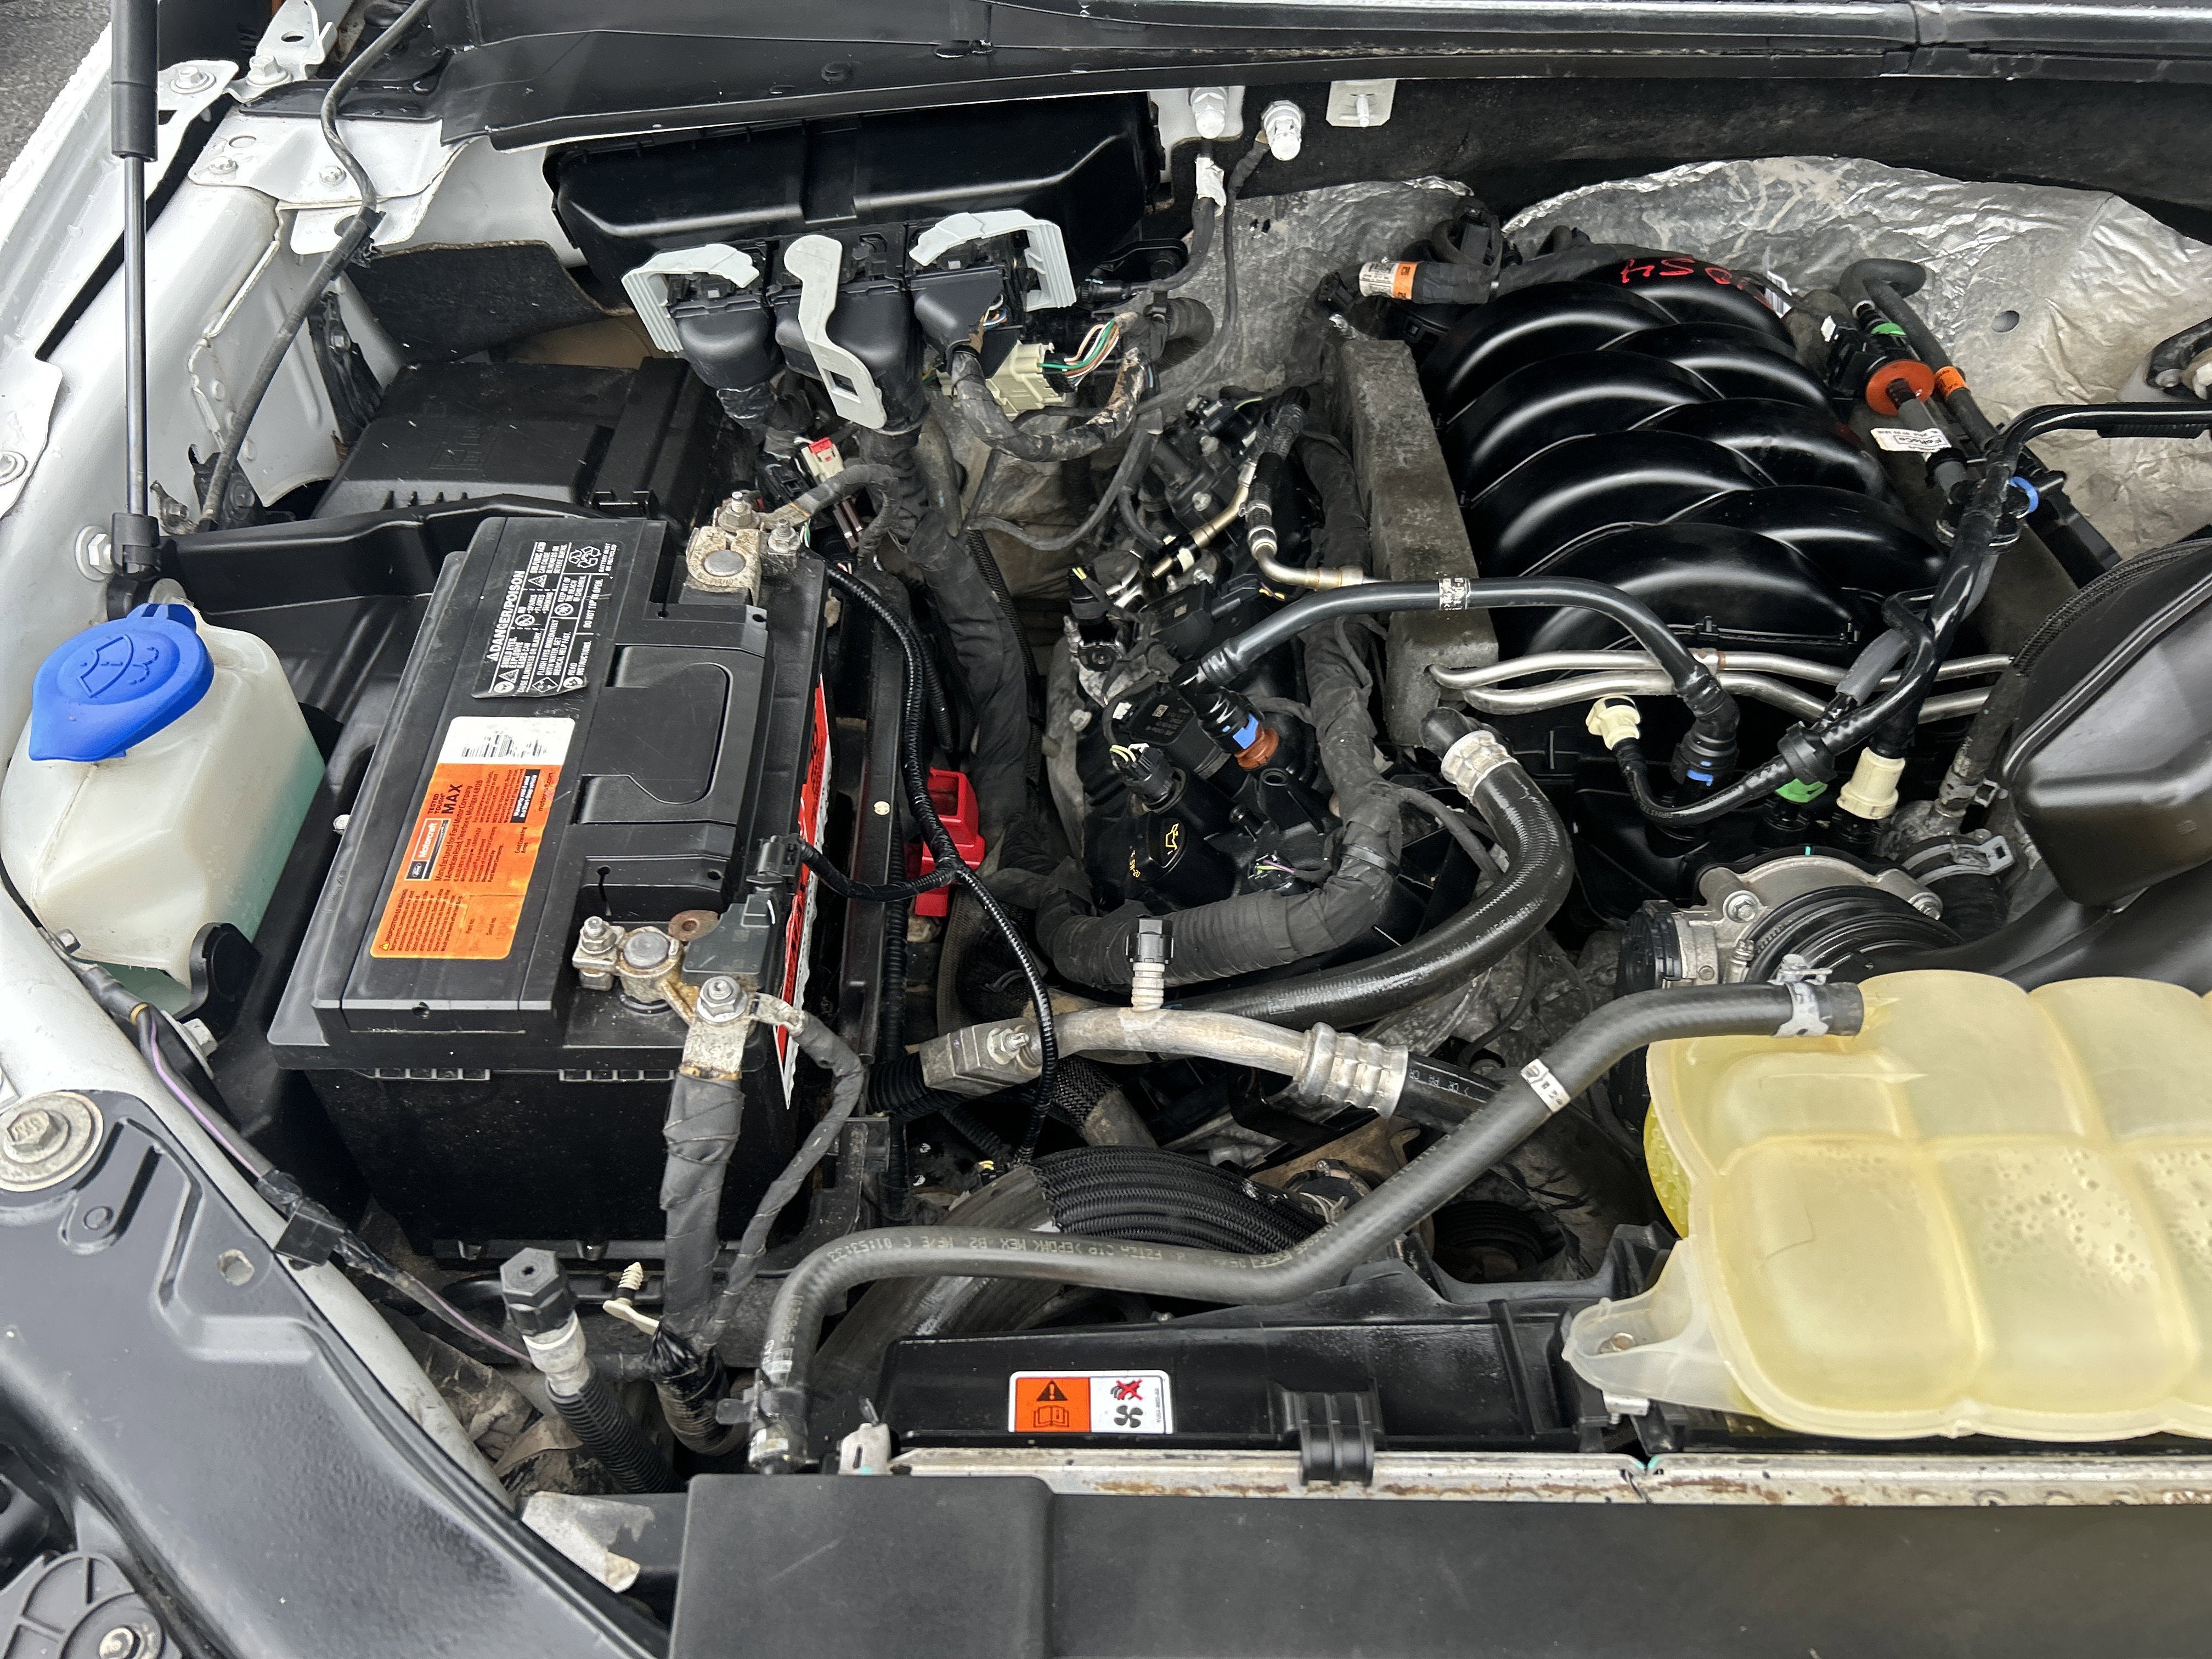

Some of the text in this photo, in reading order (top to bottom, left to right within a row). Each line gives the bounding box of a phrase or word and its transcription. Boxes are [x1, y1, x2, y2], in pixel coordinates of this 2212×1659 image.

[537, 542, 546, 552] ACID
[607, 544, 617, 565] RECYCLED
[538, 552, 550, 573] CAN CAUSE
[546, 552, 558, 573] BLINDNESS
[554, 559, 563, 573] SEVERE
[599, 554, 607, 572] BATTERY
[561, 583, 569, 591] OUT
[568, 580, 578, 594] REACH
[557, 592, 566, 602] KEEP
[588, 600, 596, 609] TIP
[489, 571, 525, 652] DANGER/POISON
[585, 610, 595, 619] NOT
[509, 642, 523, 668] EXPLOSIVE
[517, 643, 531, 668] GASES CAN
[537, 619, 558, 675] FLUSH EYES IMMEDIATELY
[558, 644, 567, 655] HELP
[500, 651, 513, 668] SHIELD
[522, 656, 535, 679] BLINDNESS
[553, 656, 565, 675] MEDICAL
[567, 663, 577, 675] READ
[545, 664, 554, 675] WITH
[473, 780, 483, 794] 48126
[427, 794, 439, 814] TESTED
[441, 785, 462, 814] MAX
[459, 786, 473, 808] Company
[466, 795, 478, 815] Michigan
[522, 788, 533, 810] Start-Stop
[453, 809, 464, 823] Motor
[514, 798, 524, 816] Warranty
[449, 825, 459, 836] Ford
[458, 816, 472, 839] Dearborn,
[418, 823, 437, 857] Motorcraft
[453, 840, 464, 854] Road,
[514, 827, 527, 853] Cold Cranking
[435, 845, 453, 881] Manufactured
[445, 855, 458, 878] American
[486, 924, 494, 935] Serial
[827, 1237, 893, 1263] 01:53:33
[1000, 1237, 1026, 1251] MEX
[763, 1339, 775, 1366] RAD
